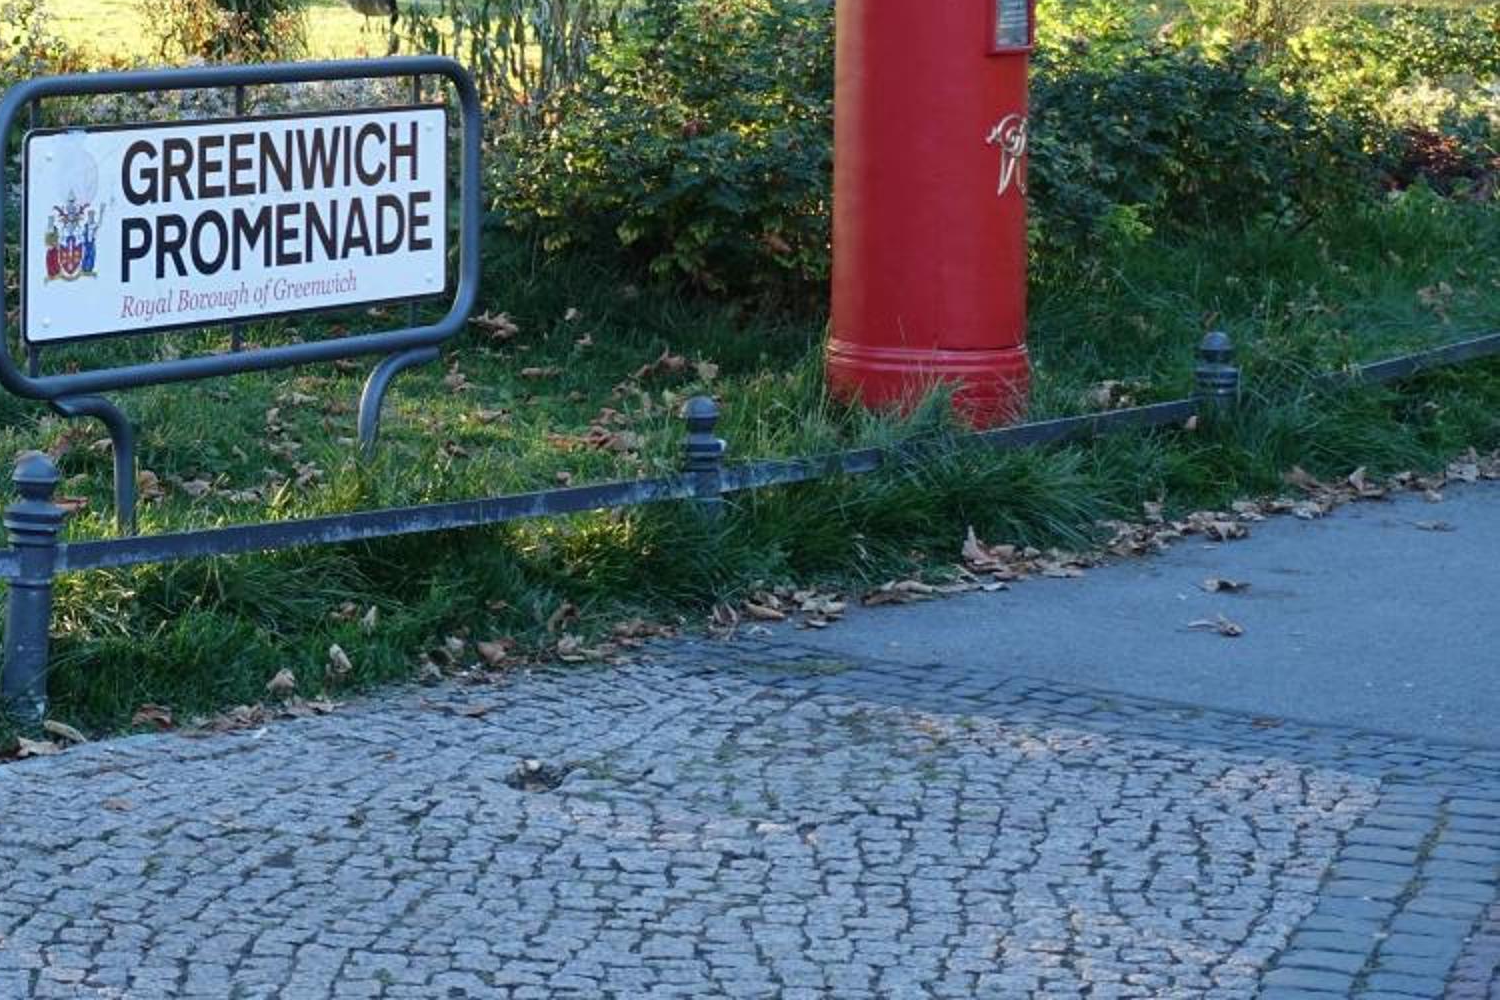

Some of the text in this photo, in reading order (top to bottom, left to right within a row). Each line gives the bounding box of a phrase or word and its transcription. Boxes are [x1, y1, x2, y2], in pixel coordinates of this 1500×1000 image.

[121, 121, 418, 206] GREENWICH
[121, 191, 432, 283] PROMENADE
[120, 269, 357, 321] Royal Borough of Greenwich
